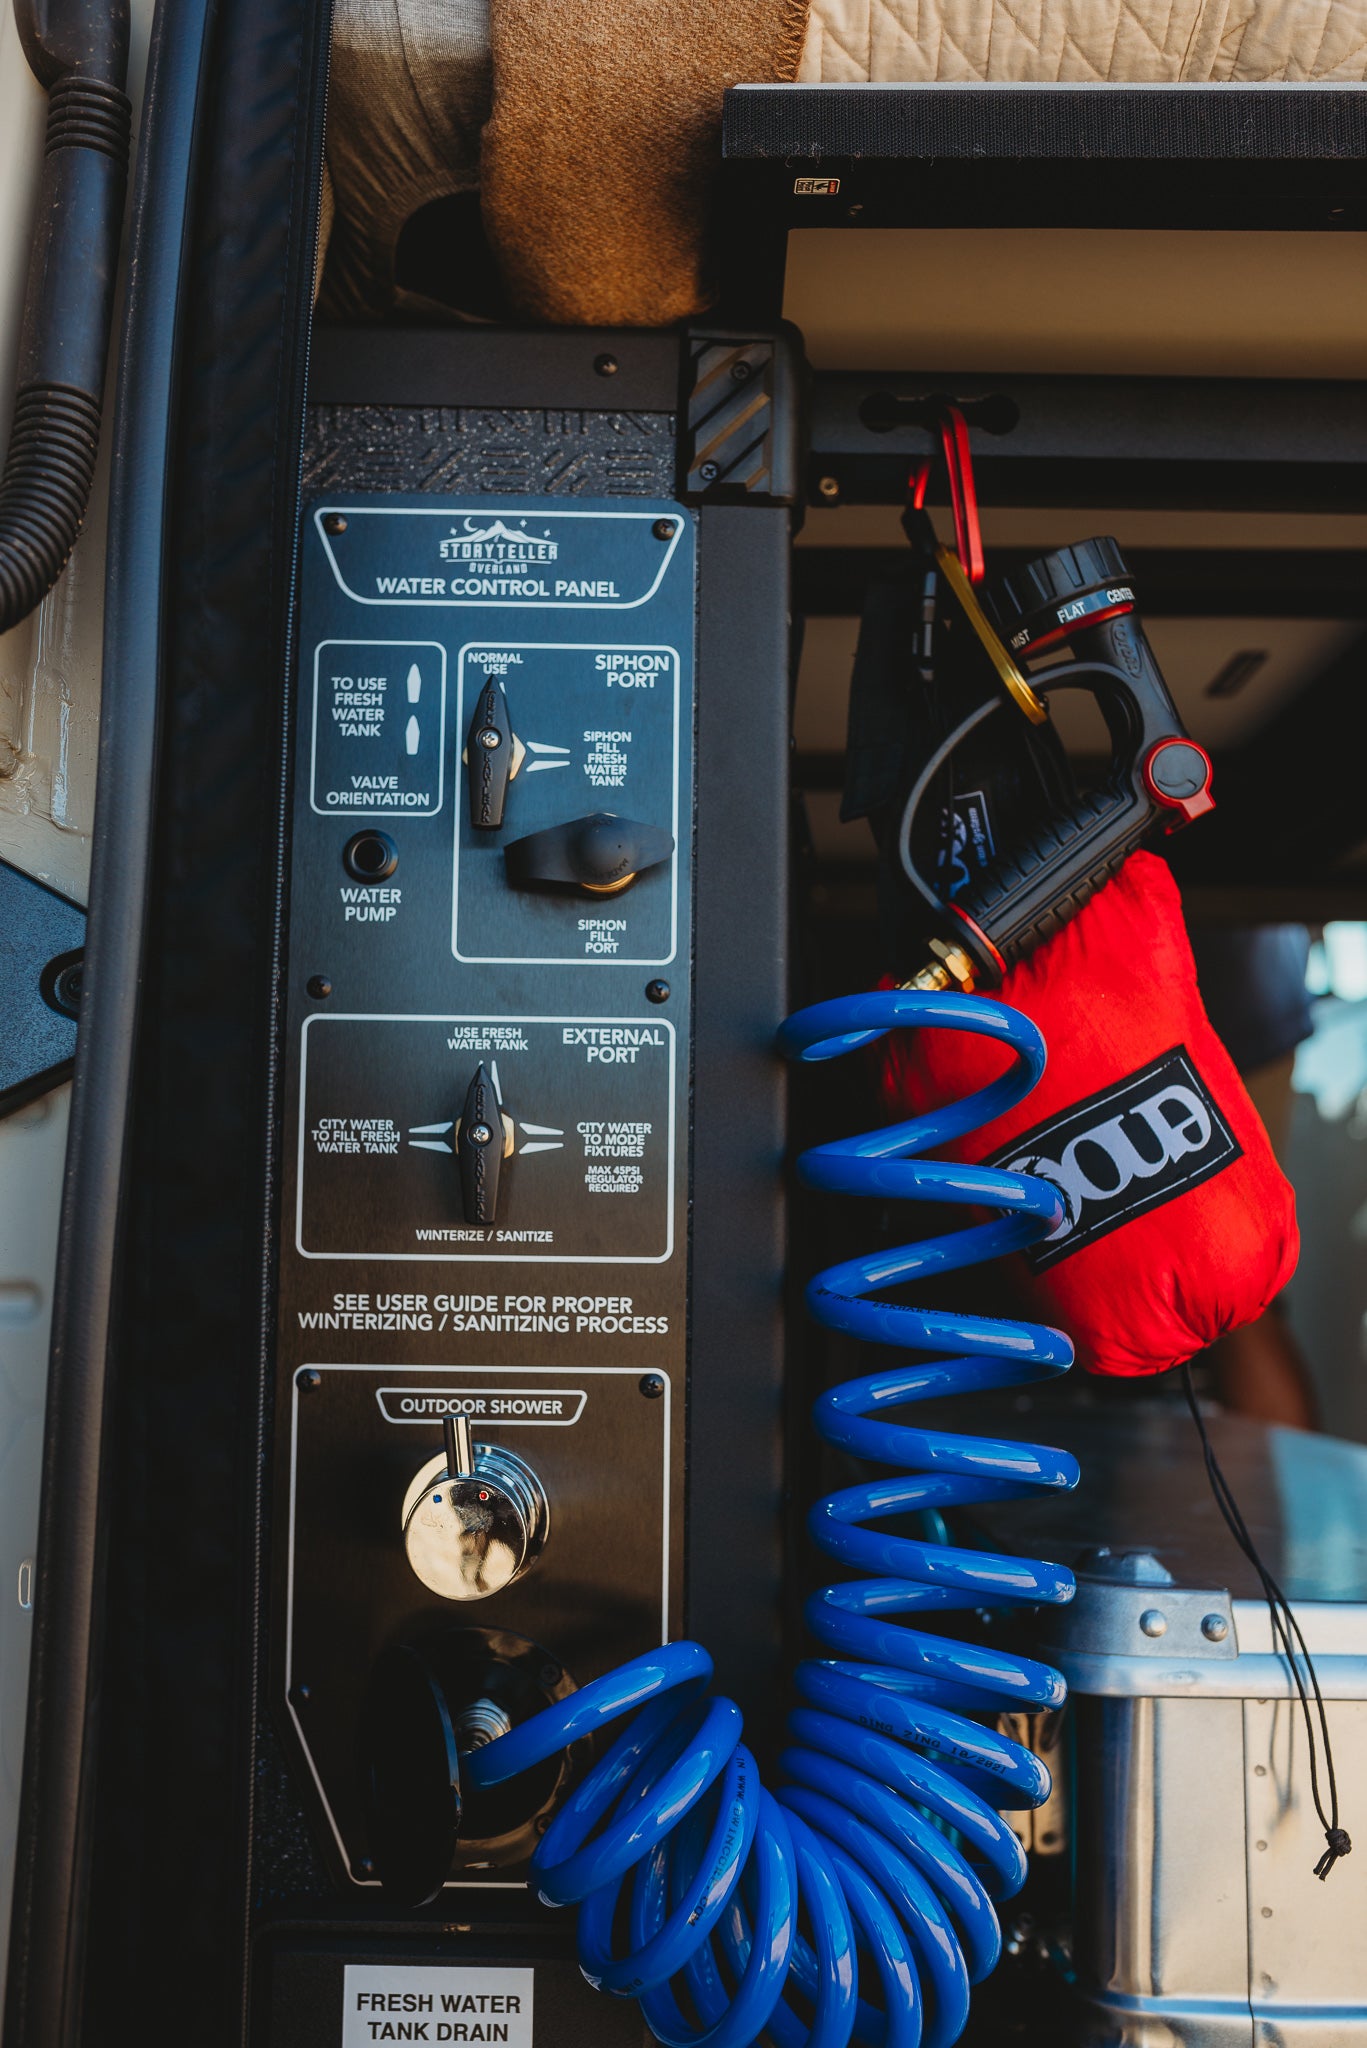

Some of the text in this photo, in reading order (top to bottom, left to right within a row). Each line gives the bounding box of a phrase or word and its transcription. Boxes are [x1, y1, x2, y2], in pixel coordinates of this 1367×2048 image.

[440, 543, 558, 560] STORYTELLER
[469, 562, 528, 575] OVERLAND
[377, 578, 620, 597] WATER CONTROL PANEL
[1106, 587, 1135, 604] CENTER
[1057, 602, 1086, 623] FLAT
[468, 653, 523, 664] NORMAL
[595, 654, 669, 671] SIPHON
[483, 664, 507, 674] USE
[332, 677, 387, 690] TO USE
[607, 672, 658, 688] PORT
[335, 693, 382, 705] FRESH
[332, 708, 384, 721] WATER
[339, 724, 380, 736] TANK
[584, 731, 631, 742] SIPHON
[596, 742, 620, 753] FILL
[588, 753, 627, 764] FRESH
[584, 764, 627, 775] WATER
[351, 776, 398, 789] VALVE
[590, 776, 624, 786] TANK
[327, 792, 429, 806] ORIENTATION
[341, 888, 401, 903] WATER
[345, 907, 396, 921] PUMP
[578, 920, 626, 931] SIPHON
[590, 931, 614, 942] FILL
[586, 942, 619, 953] PORT
[455, 1027, 521, 1039] USE FRESH
[563, 1028, 664, 1045] EXTERNAL
[447, 1039, 528, 1050] WATER TANK
[587, 1047, 639, 1063] PORT
[319, 1119, 393, 1130] CITY WATER
[577, 1122, 651, 1133] CITY WATER
[312, 1130, 400, 1142] TO FILL FRESH
[583, 1134, 645, 1145] TO MODE
[317, 1142, 398, 1153] WATER TANK
[585, 1146, 643, 1157] FIXTURES
[588, 1165, 640, 1175] MAX 45PSI
[584, 1174, 643, 1185] REGULATOR
[588, 1183, 639, 1193] REQUIRED
[416, 1230, 553, 1242] WINTERIZE / SANITIZE
[334, 1294, 632, 1313] SEE USER GUIDE FOR PROPER
[298, 1313, 668, 1333] WINTERIZING / SANITIZING PROCESS
[401, 1399, 562, 1414] OUTDOOR SHOWER
[903, 1729, 941, 1749] ZING
[357, 1993, 520, 2013] FRESH WATER
[368, 2022, 508, 2041] TANK DRAIN
